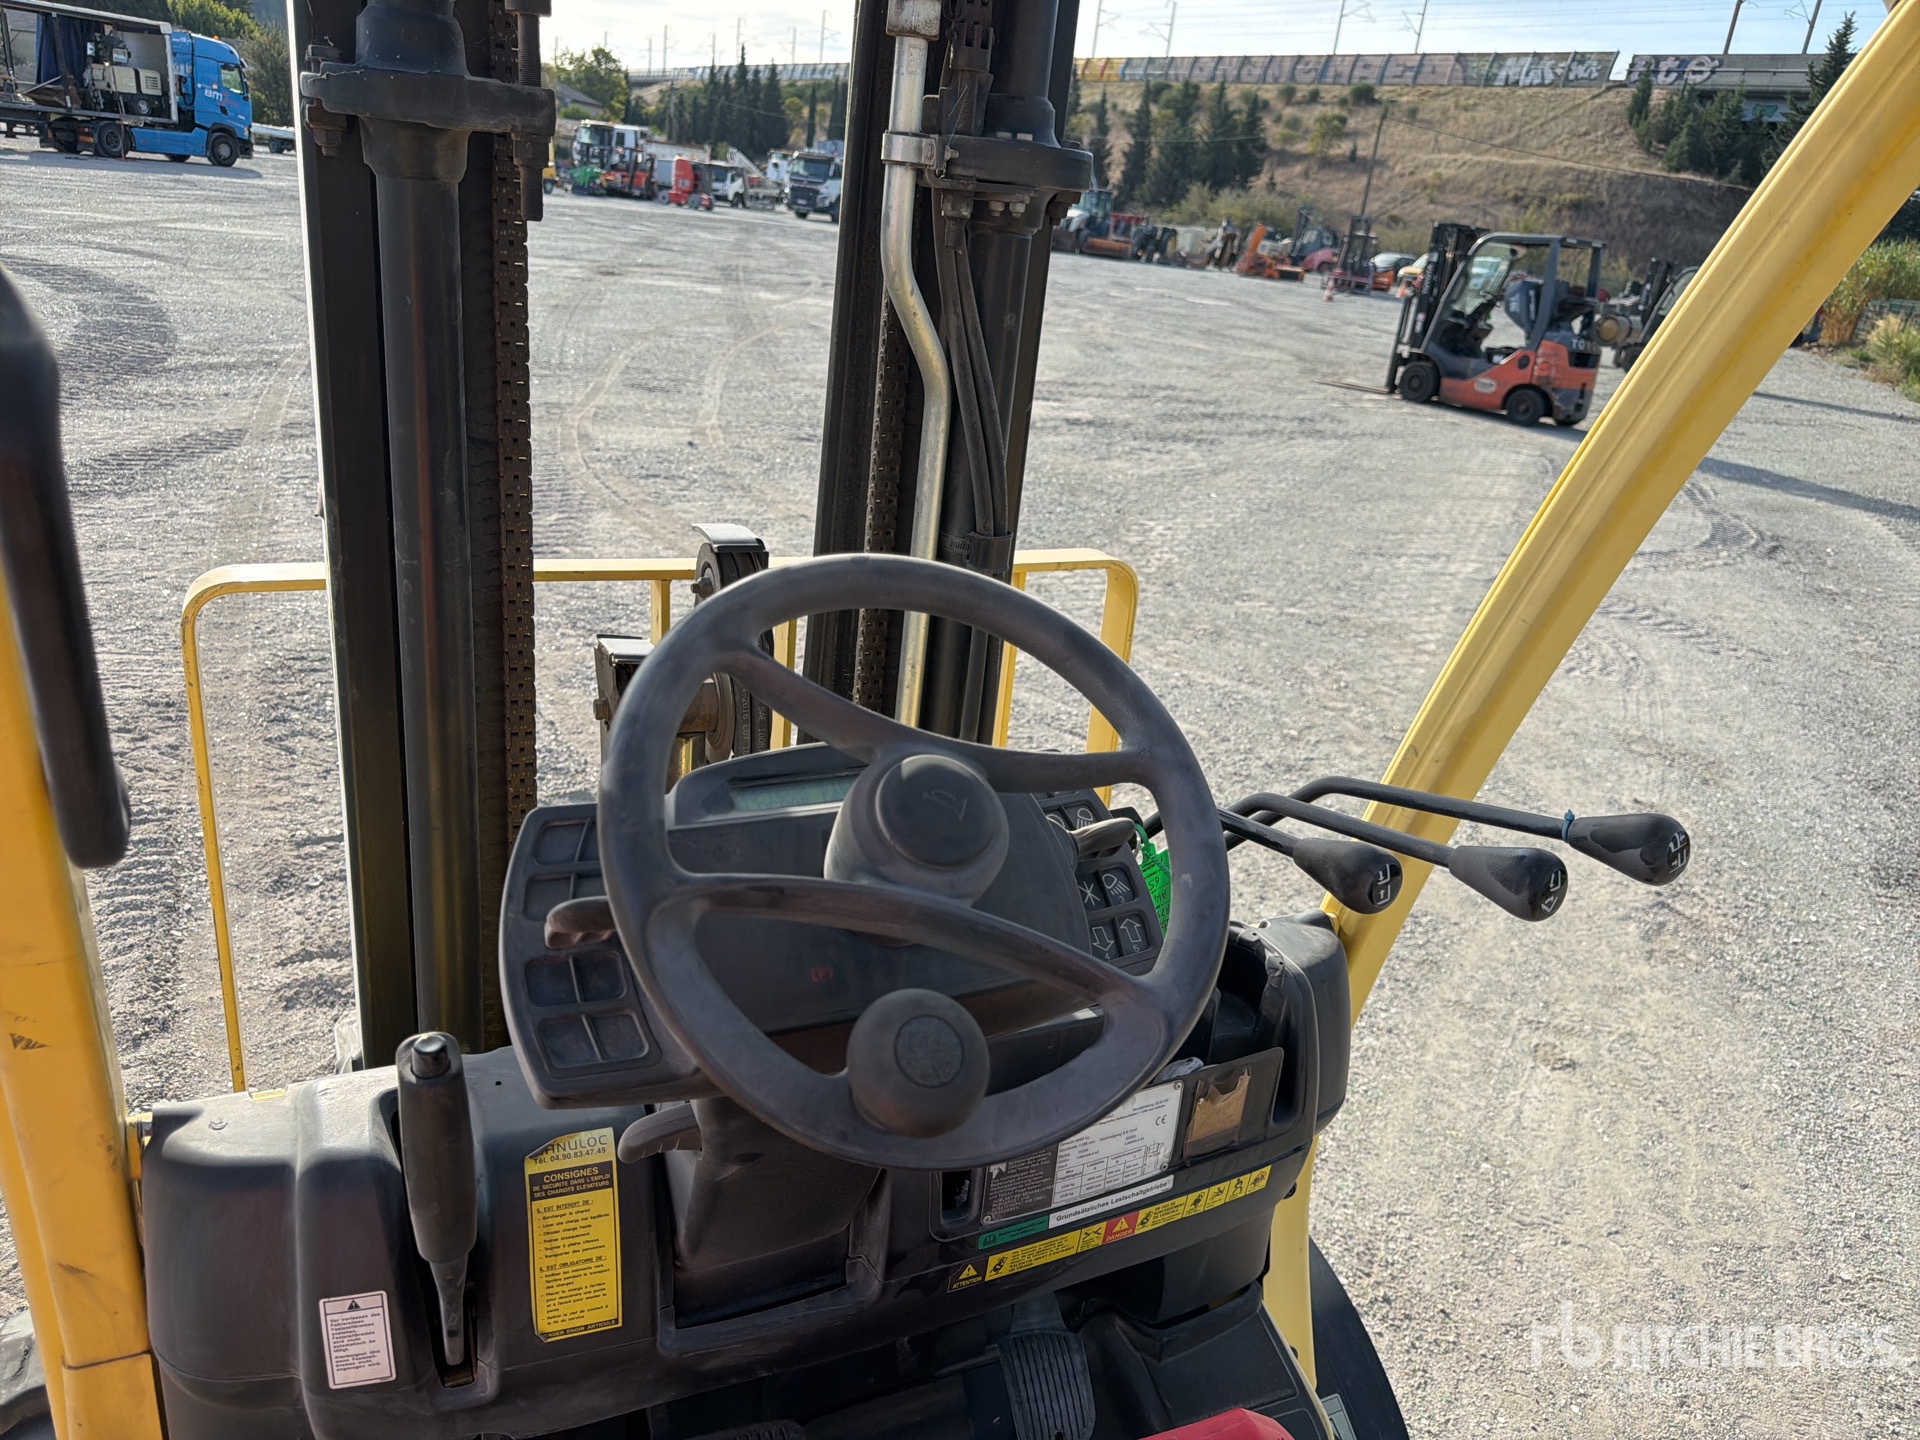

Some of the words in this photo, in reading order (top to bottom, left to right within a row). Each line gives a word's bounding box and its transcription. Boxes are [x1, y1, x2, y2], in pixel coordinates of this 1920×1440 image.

[758, 706, 766, 721] SAE
[1132, 944, 1140, 952] 5
[1156, 1114, 1167, 1126] CE
[550, 1146, 606, 1162] 04.90.83.47.49
[543, 1166, 599, 1183] CONSIGNES
[587, 1173, 611, 1182] L'EMPLOI
[547, 1186, 574, 1196] CHARIOTS
[556, 1201, 580, 1210] INTERDIT
[1056, 1201, 1109, 1221] Grundsätzliches
[1111, 1182, 1167, 1204] Lastschaltgetriebe
[1106, 1229, 1132, 1242] DANGER
[952, 1276, 982, 1289] ATTENTION
